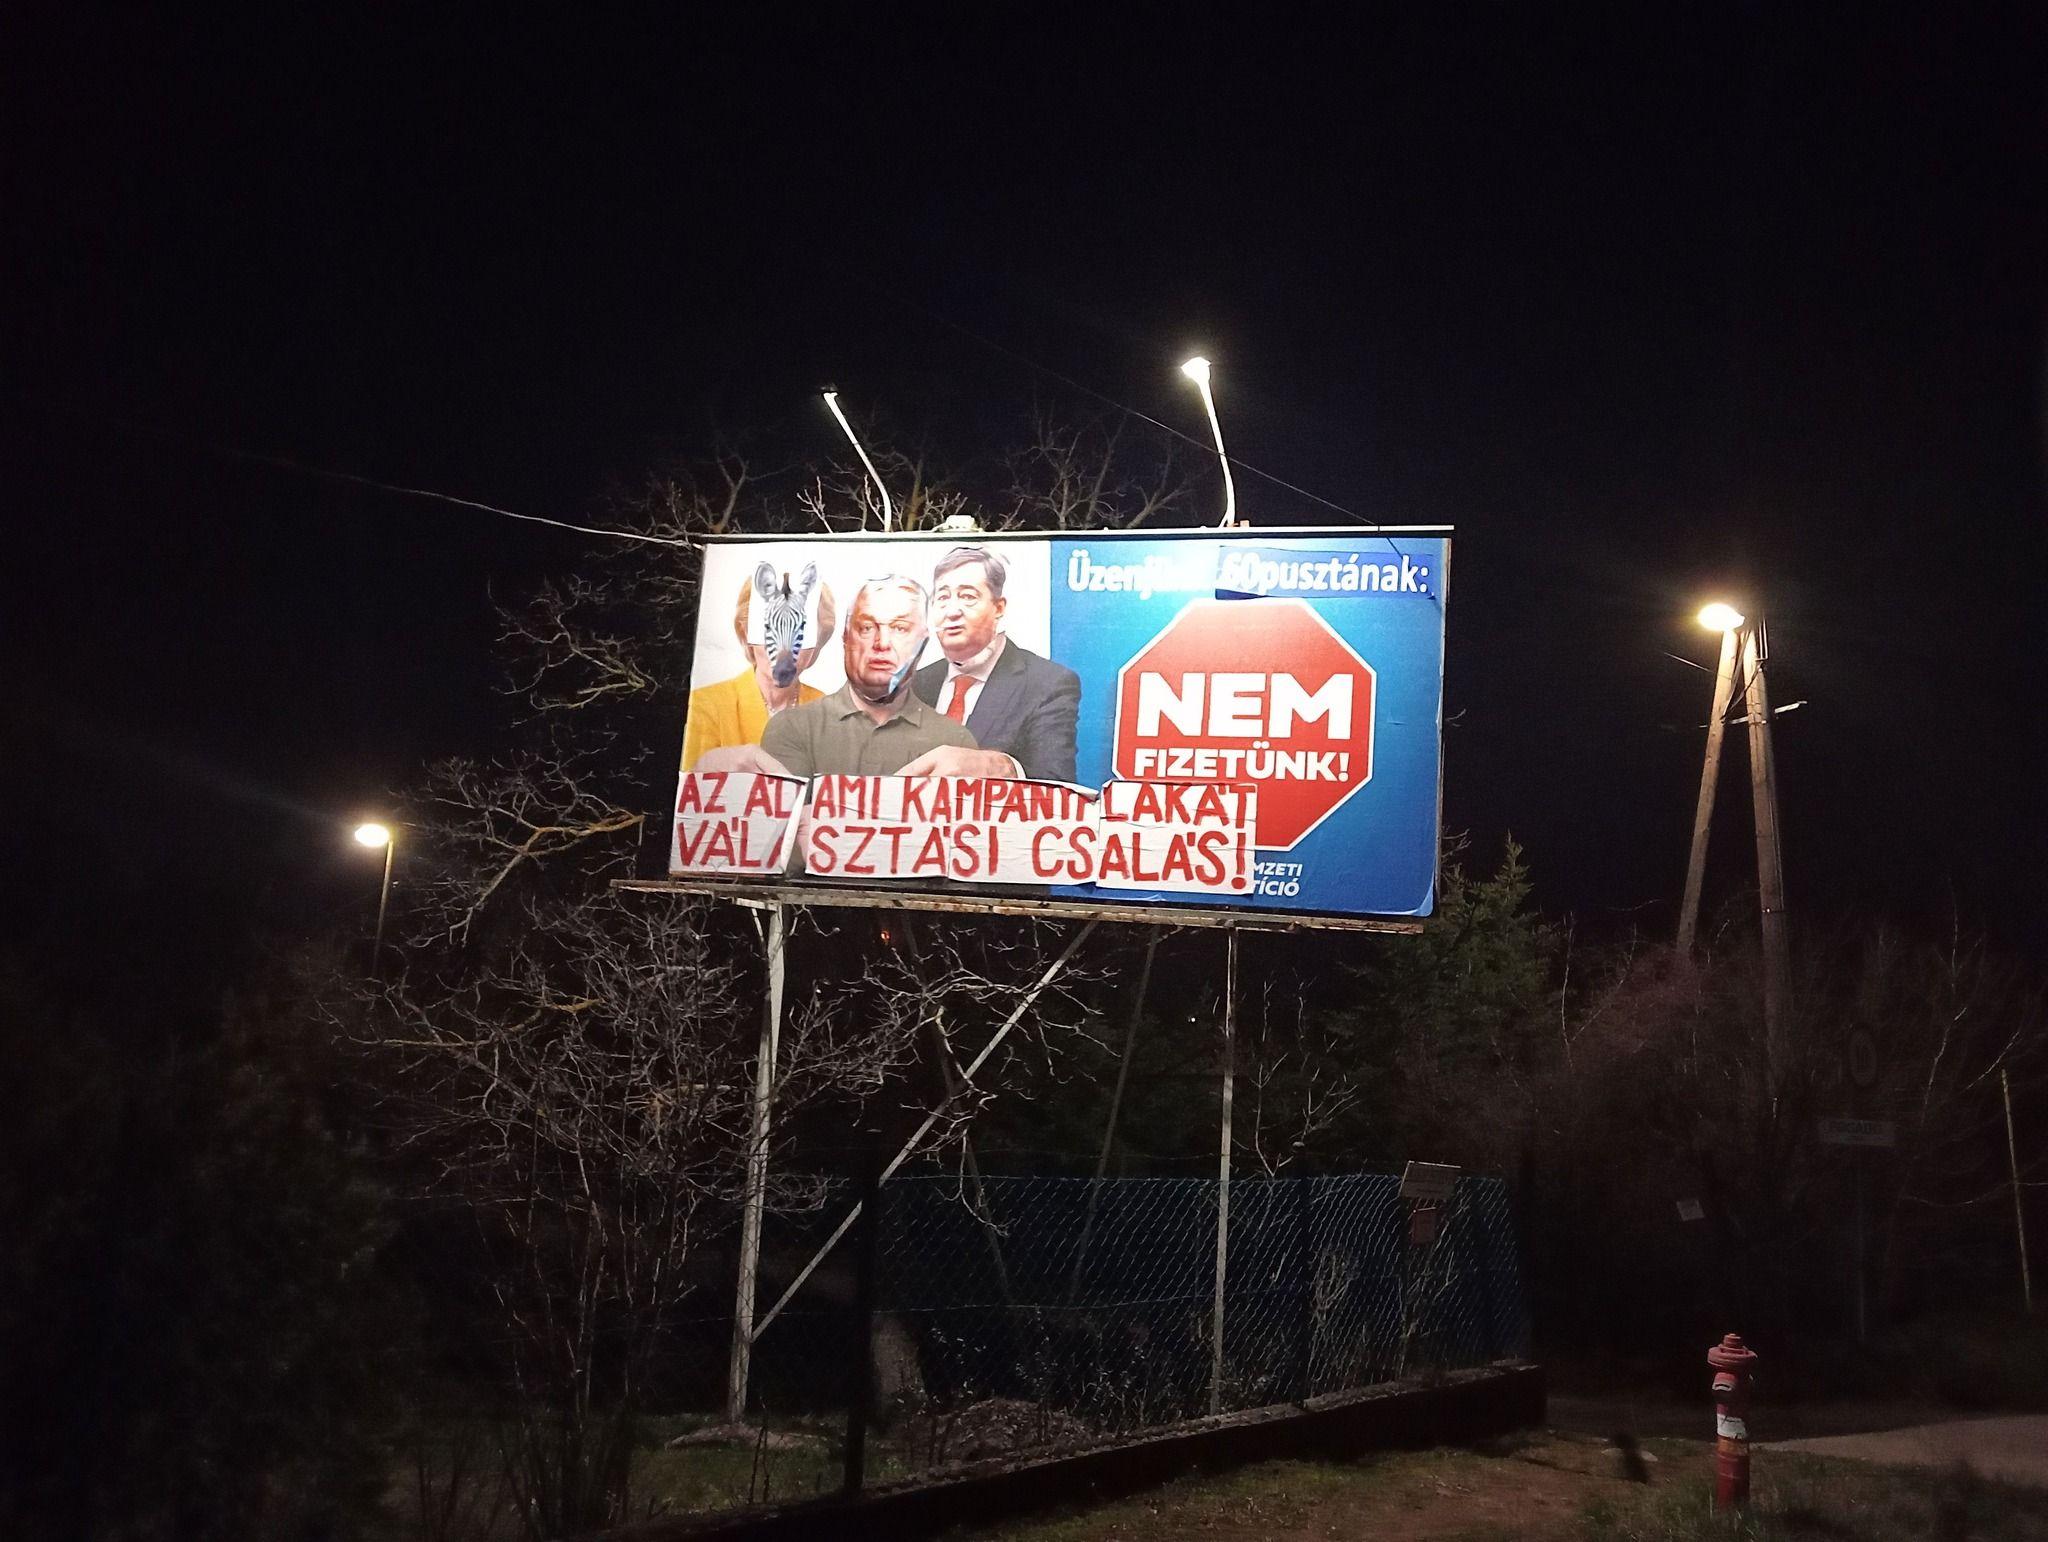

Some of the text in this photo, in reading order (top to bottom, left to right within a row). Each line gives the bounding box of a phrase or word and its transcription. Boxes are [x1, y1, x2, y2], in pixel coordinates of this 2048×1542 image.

[1136, 671, 1353, 740] NEM
[1134, 740, 1350, 782] FIZETÜNK!
[677, 773, 728, 814] AZ
[744, 773, 881, 820] ÁLAMI
[1031, 825, 1248, 890] CSALÁS!
